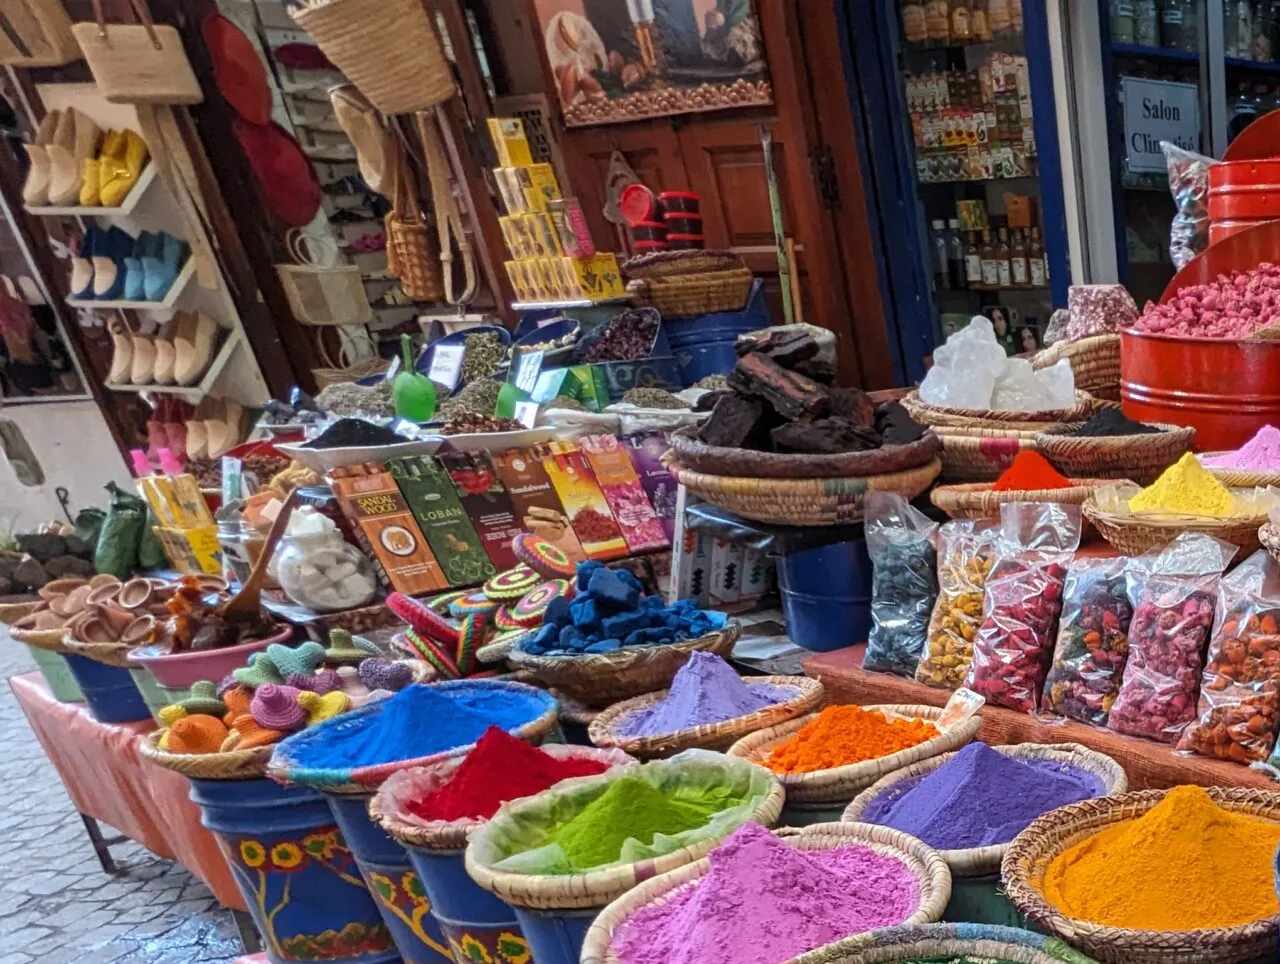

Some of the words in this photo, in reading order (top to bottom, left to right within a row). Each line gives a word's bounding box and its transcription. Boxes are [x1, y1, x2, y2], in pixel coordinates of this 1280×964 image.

[1142, 97, 1181, 121] Salon
[1131, 132, 1194, 154] Climtisé
[420, 507, 462, 522] LOBAN
